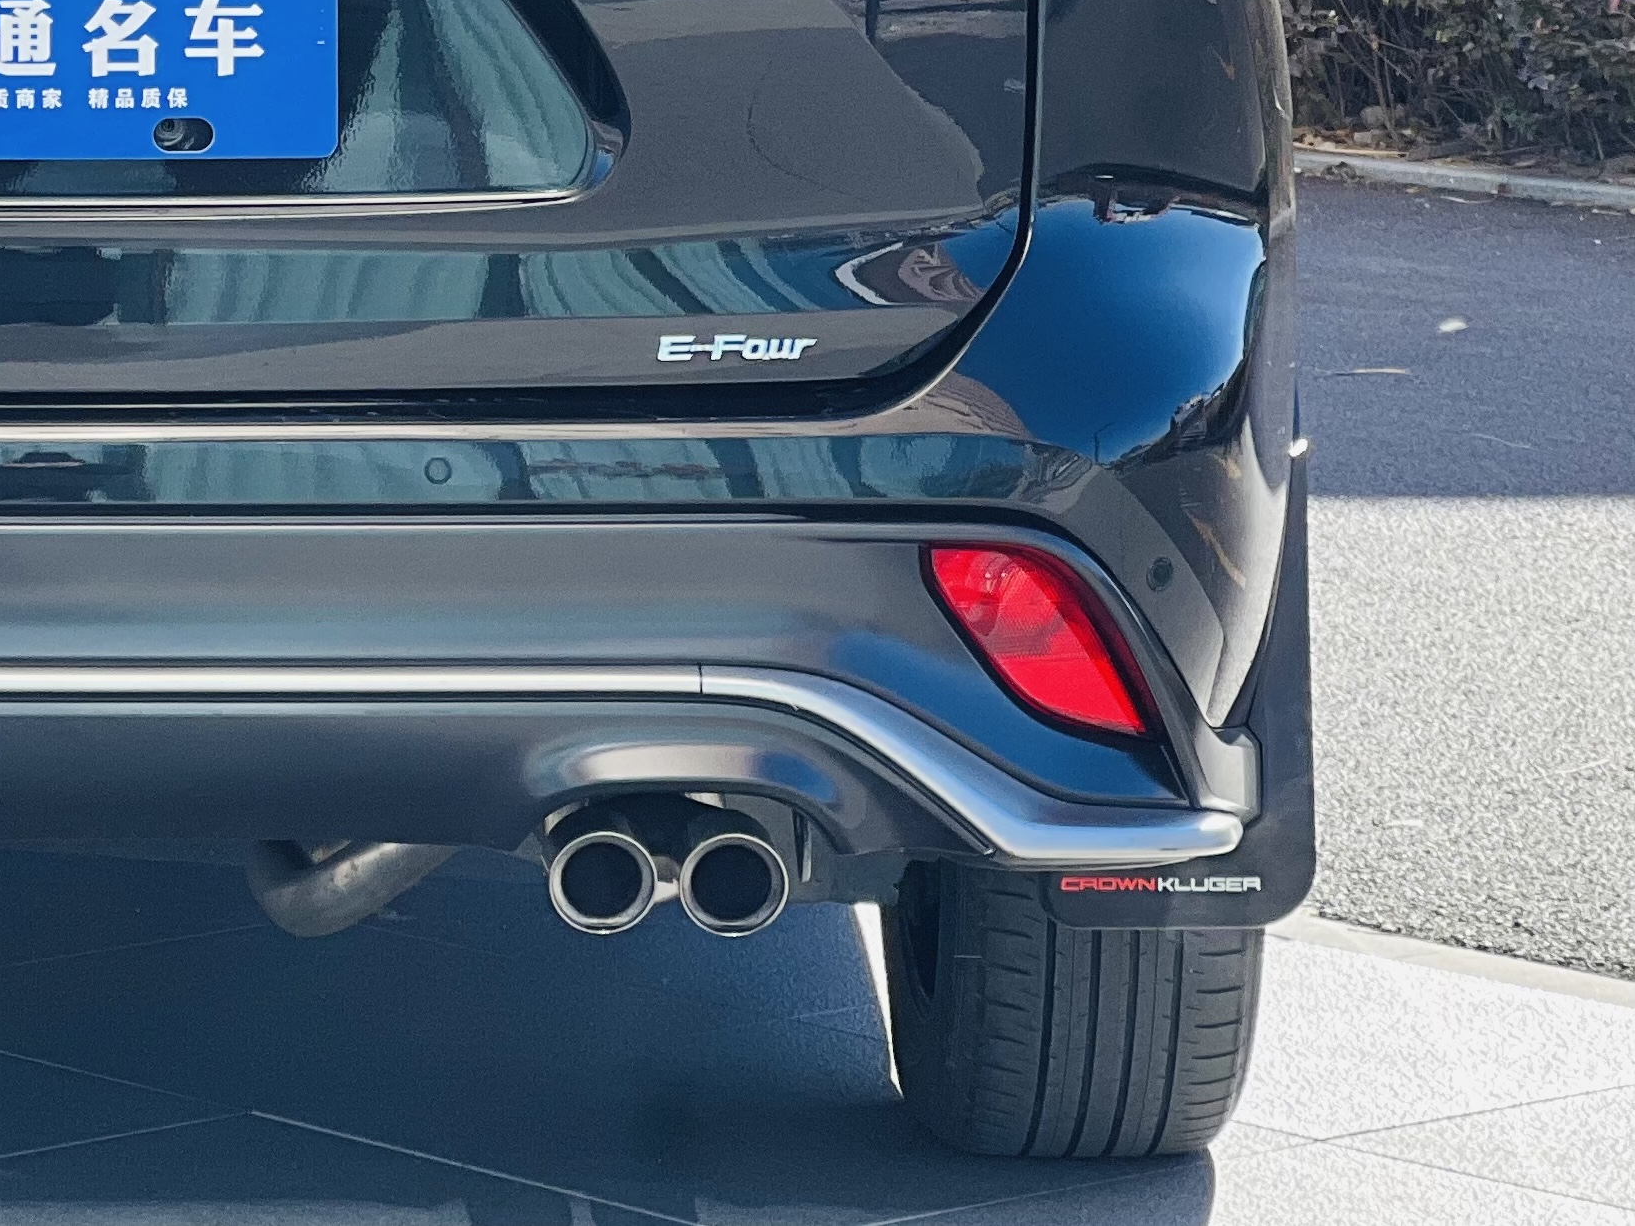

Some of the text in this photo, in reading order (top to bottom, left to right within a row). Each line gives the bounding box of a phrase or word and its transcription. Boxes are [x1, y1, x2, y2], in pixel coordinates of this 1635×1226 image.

[88, 87, 190, 110] 精品质保
[657, 334, 818, 362] E-Four
